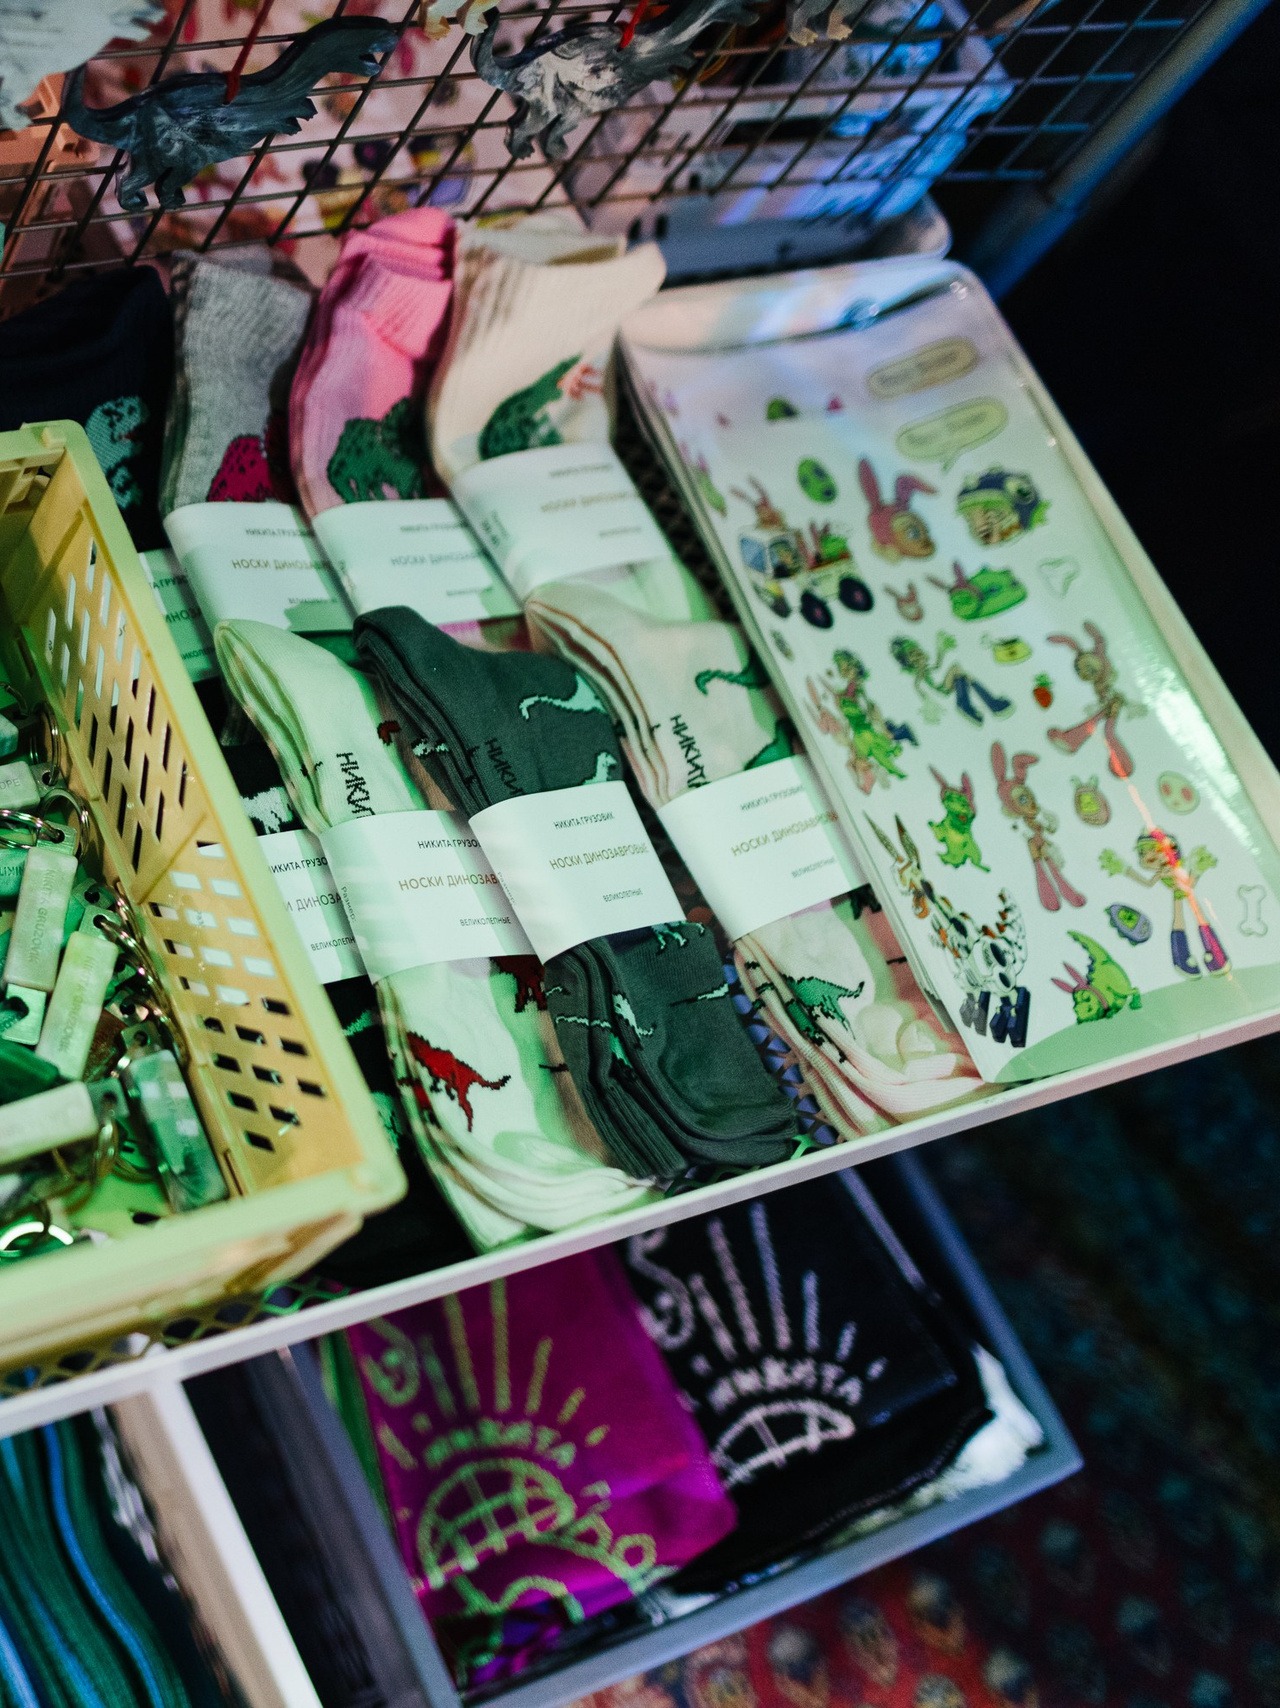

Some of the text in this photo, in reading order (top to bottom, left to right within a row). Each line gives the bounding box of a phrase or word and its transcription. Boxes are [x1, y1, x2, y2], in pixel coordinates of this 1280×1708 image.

[231, 559, 269, 569] НОСКИ
[418, 839, 481, 849] НИКИТА ГРУЗО
[731, 834, 769, 856] НОСКИ
[548, 855, 583, 870] НОСКИ
[398, 876, 444, 891] НОСКИ
[460, 916, 511, 927] ВЕЛИКОЛЕПНЫЕ
